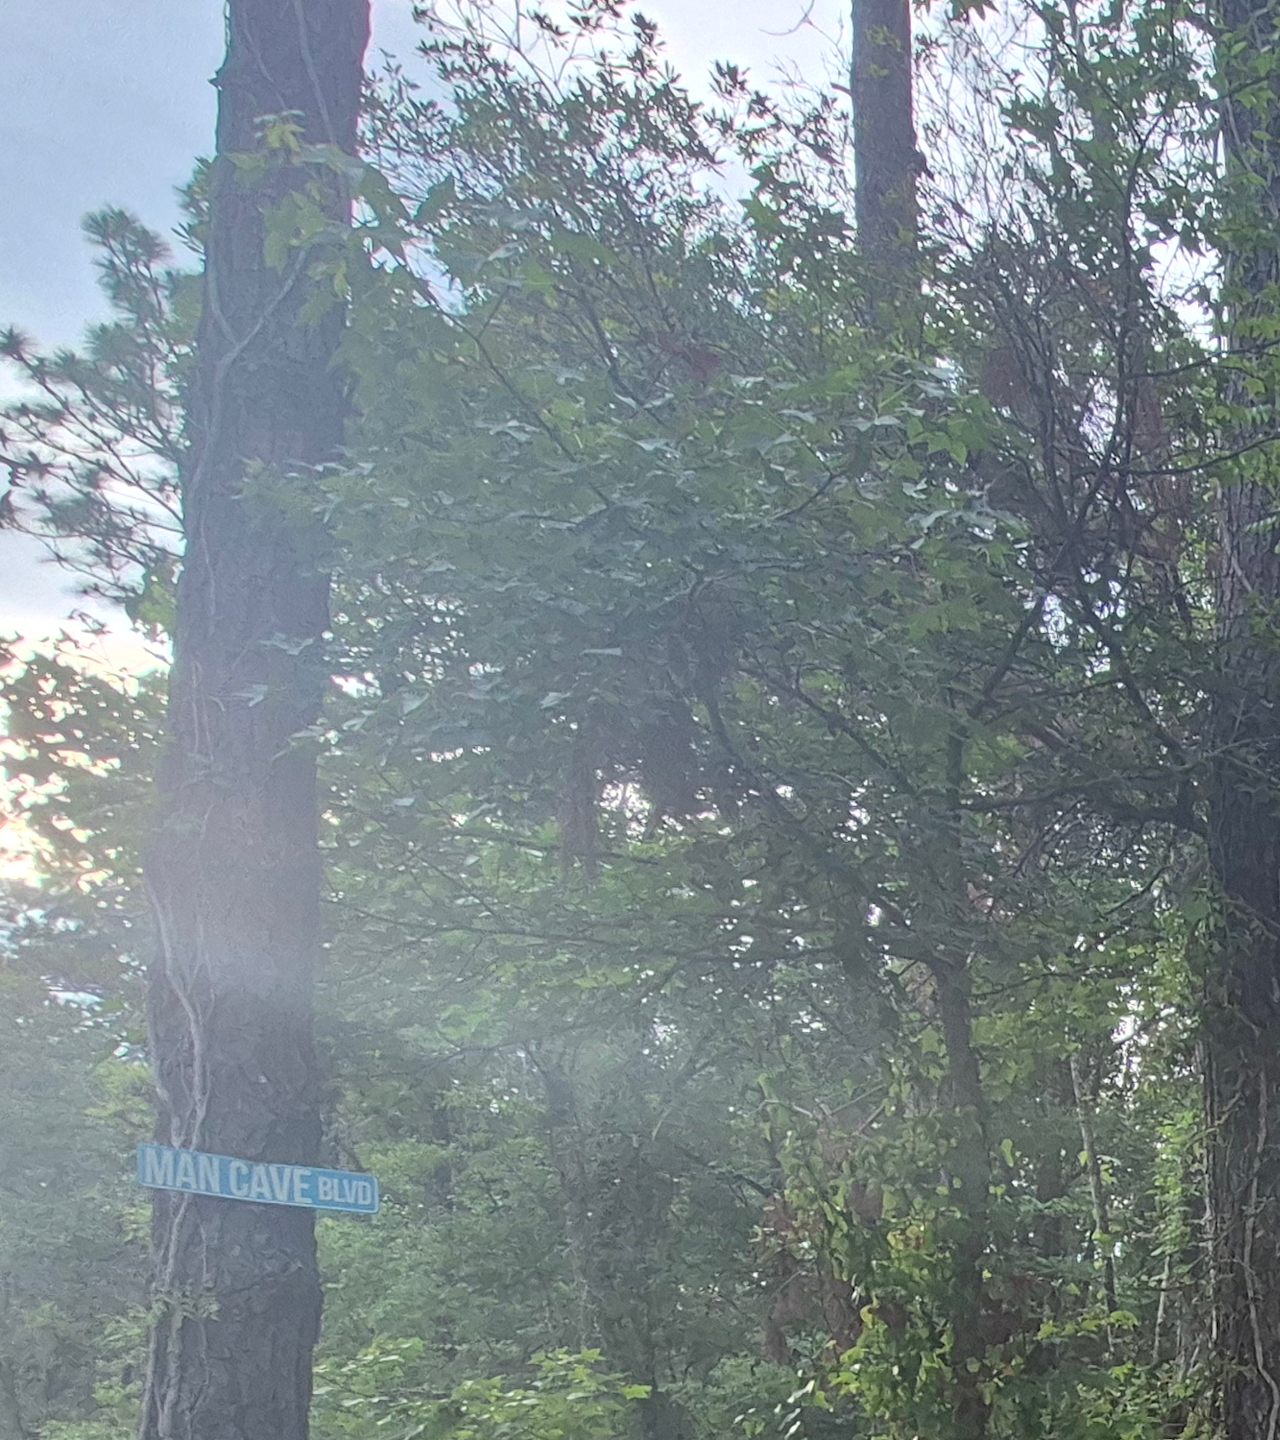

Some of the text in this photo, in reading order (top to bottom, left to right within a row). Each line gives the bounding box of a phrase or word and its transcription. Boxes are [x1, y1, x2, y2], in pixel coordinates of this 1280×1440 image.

[144, 1149, 372, 1206] MAN CAVE BLVD
